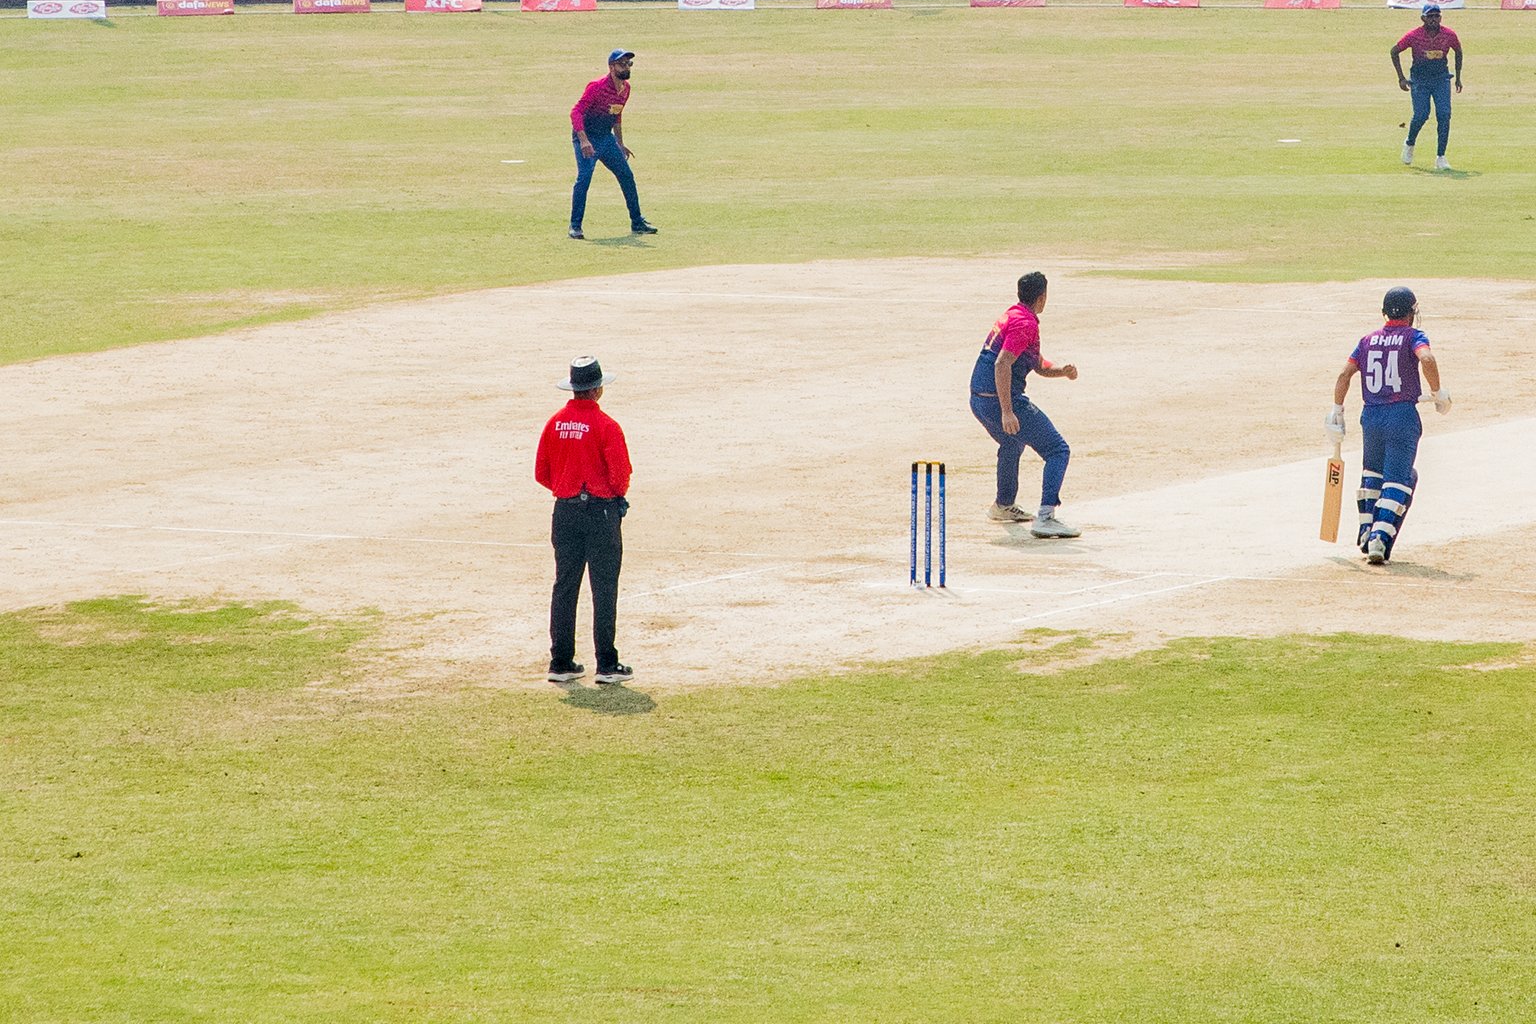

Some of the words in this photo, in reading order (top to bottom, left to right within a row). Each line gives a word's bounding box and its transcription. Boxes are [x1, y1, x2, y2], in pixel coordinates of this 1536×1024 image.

[1369, 335, 1403, 346] BHIM
[1366, 350, 1402, 394] 54
[555, 420, 590, 433] Emirates
[1328, 462, 1341, 486] ZAP
